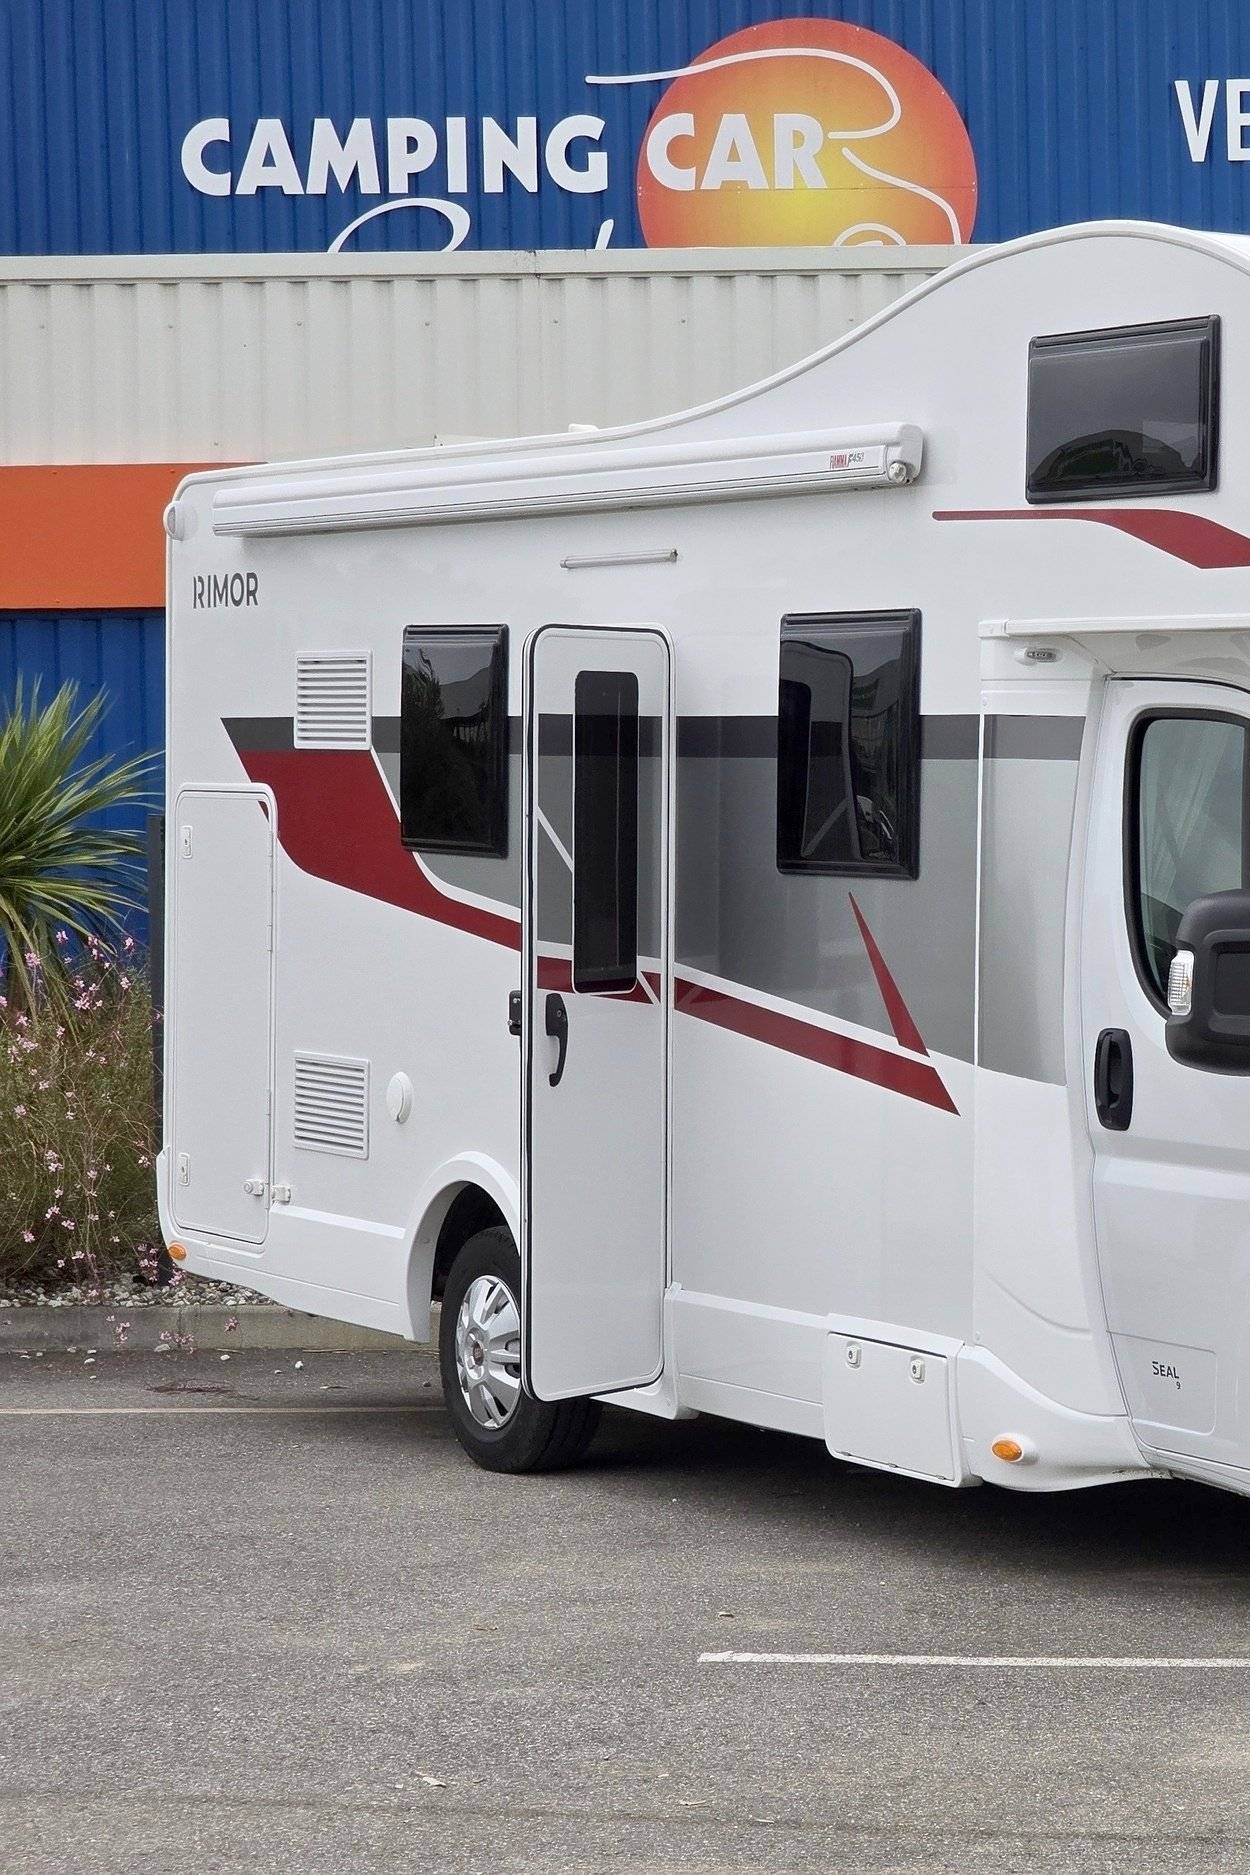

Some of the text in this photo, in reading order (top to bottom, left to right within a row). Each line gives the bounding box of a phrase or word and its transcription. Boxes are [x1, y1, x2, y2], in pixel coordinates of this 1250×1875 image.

[181, 112, 828, 196] CAMPING CAR
[193, 572, 259, 609] RIMOR
[1152, 1360, 1180, 1379] SEAL
